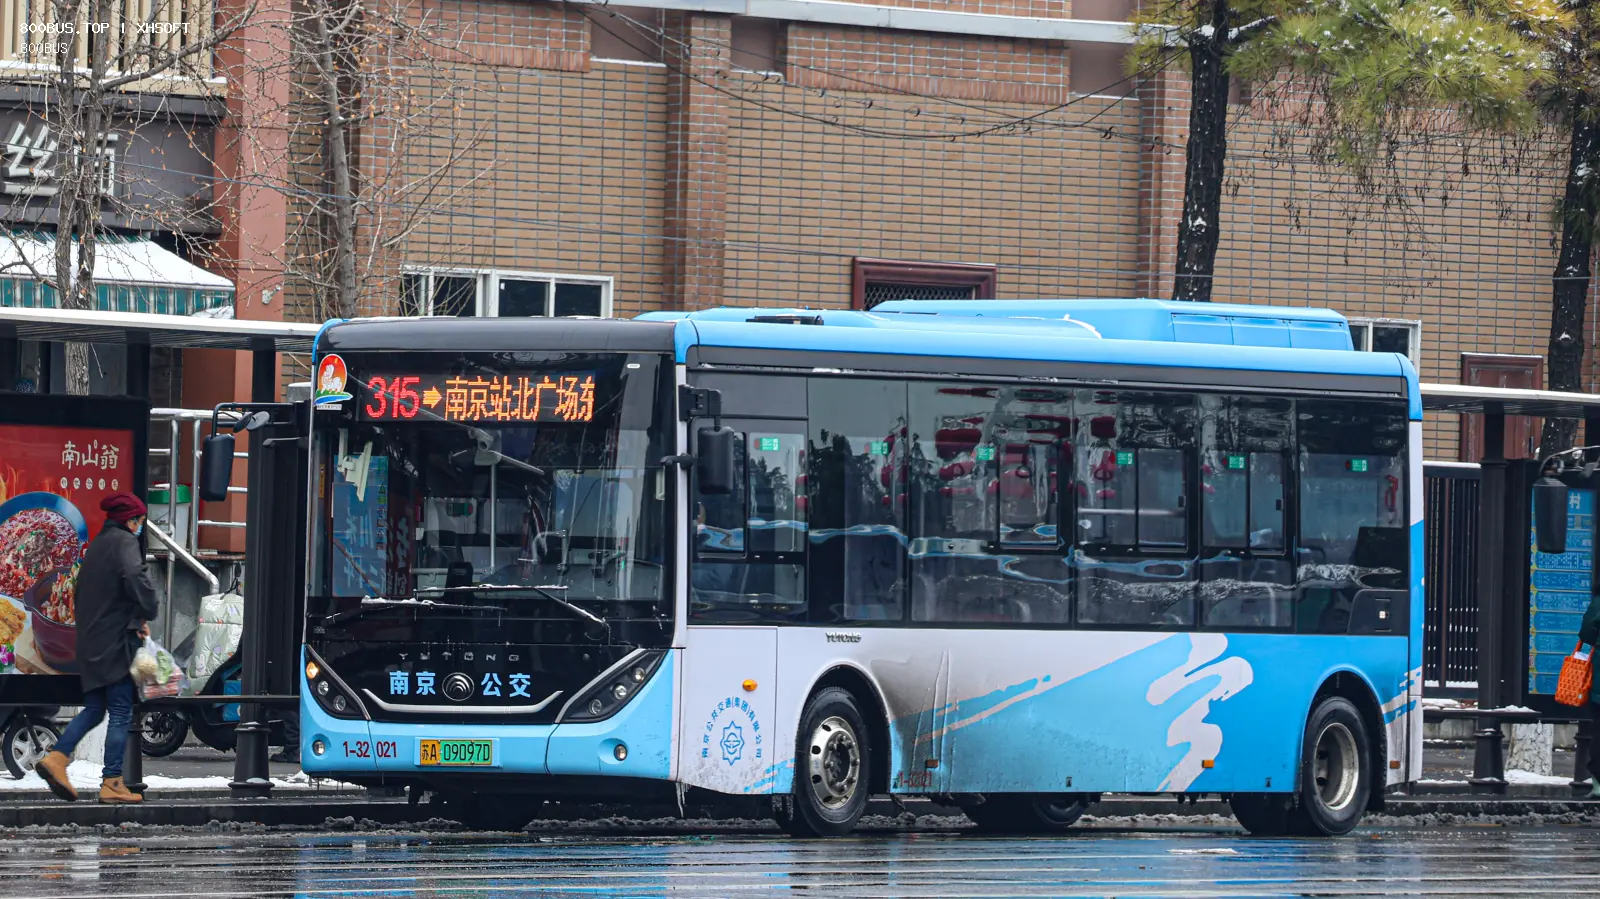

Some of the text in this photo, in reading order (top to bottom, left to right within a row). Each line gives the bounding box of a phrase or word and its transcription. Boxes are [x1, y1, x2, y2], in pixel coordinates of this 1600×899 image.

[366, 376, 420, 418] 315
[445, 375, 596, 421] 南京站北广场东
[61, 440, 120, 470] 南山翁
[389, 670, 532, 698] 南京 公交
